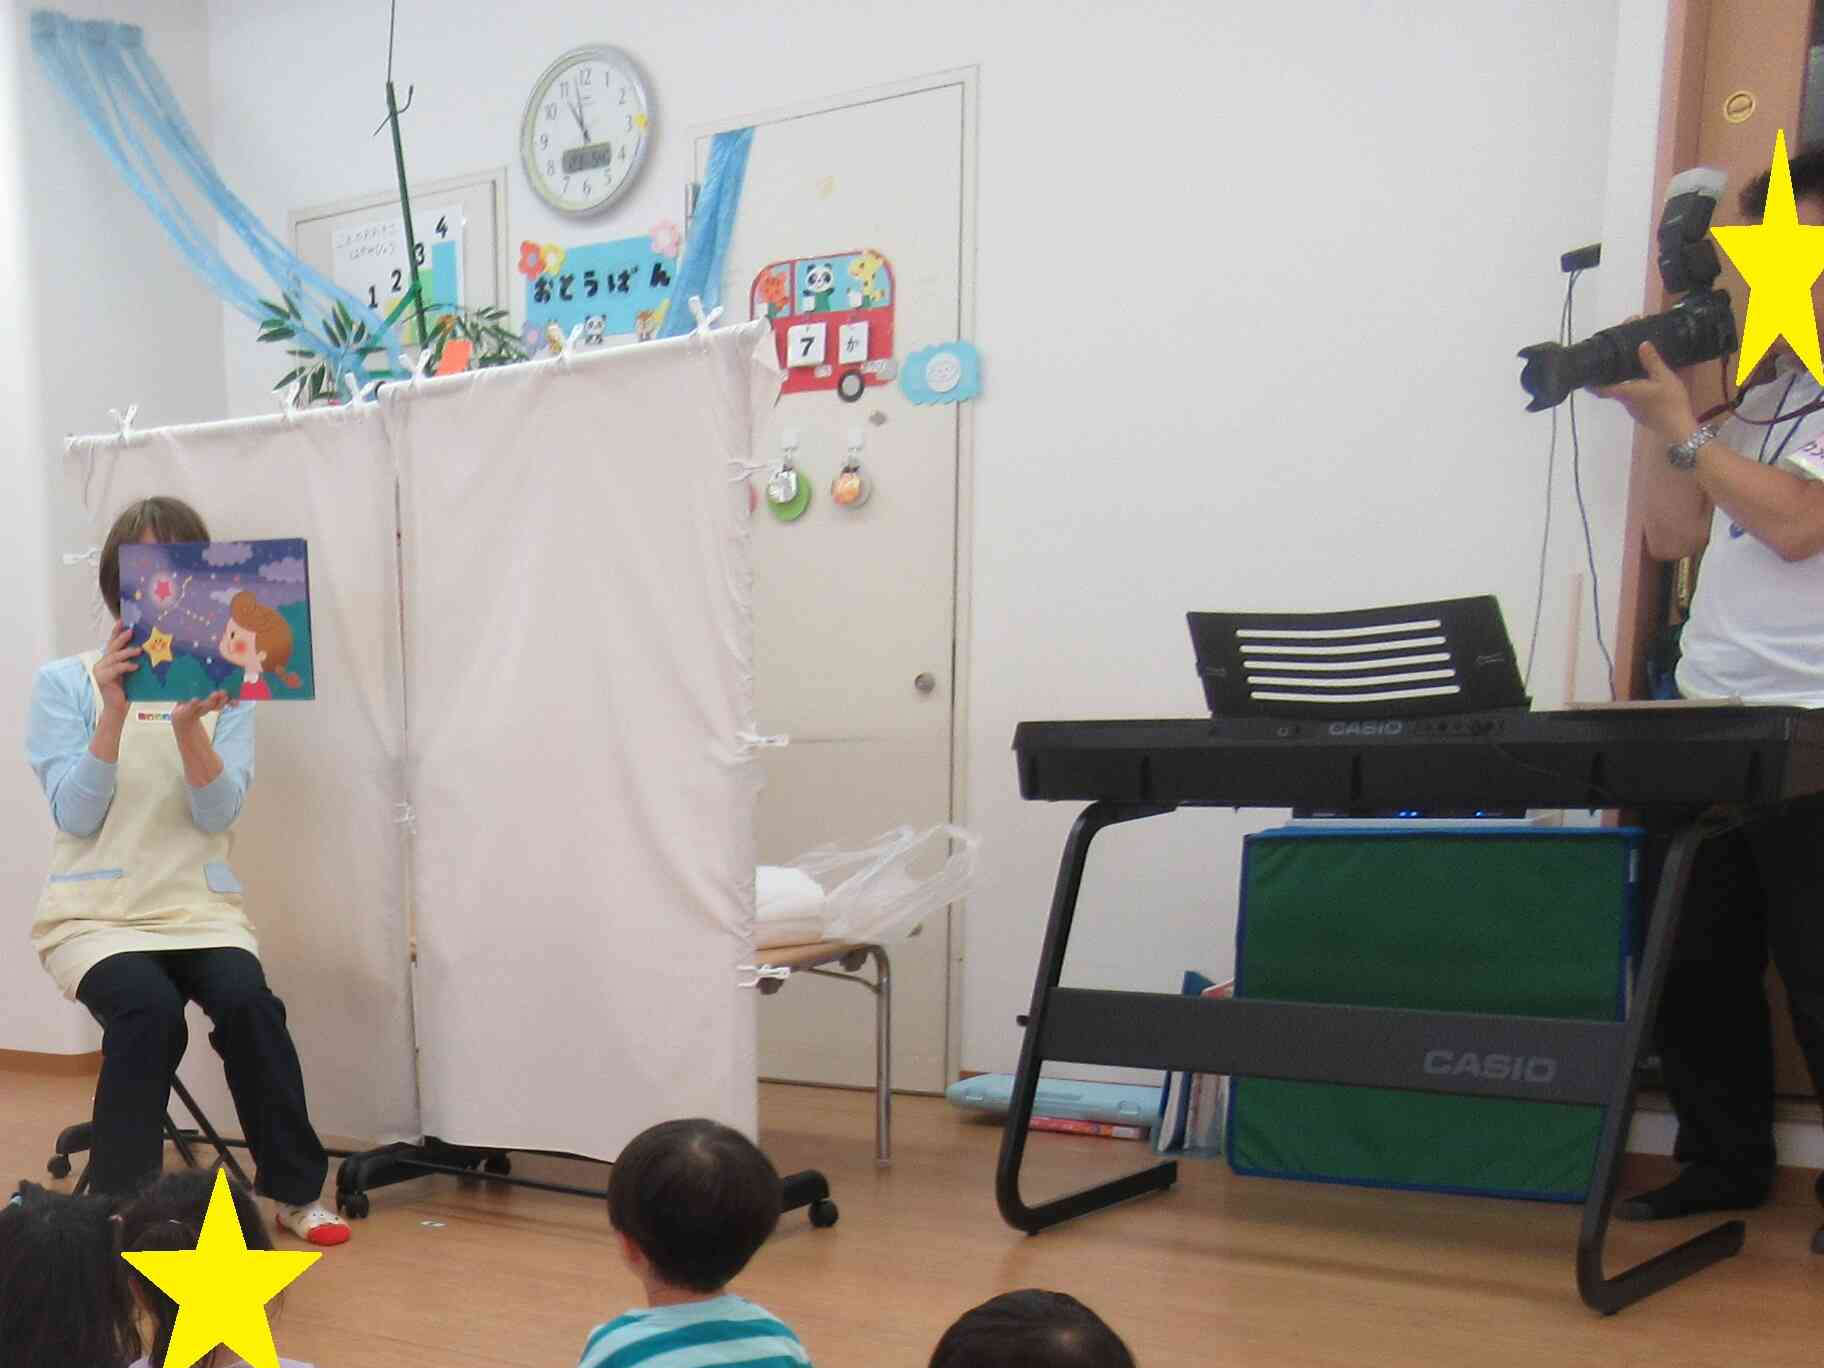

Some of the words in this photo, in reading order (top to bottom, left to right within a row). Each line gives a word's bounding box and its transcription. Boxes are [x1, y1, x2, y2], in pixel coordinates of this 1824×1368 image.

[579, 68, 592, 85] 12
[605, 72, 609, 88] 1
[560, 81, 569, 99] 11
[619, 87, 626, 104] 2
[544, 102, 557, 120] 10
[626, 115, 633, 132] 3
[540, 134, 549, 150] 9
[617, 145, 626, 160] 4
[547, 160, 555, 176] 8
[604, 168, 612, 185] 5
[561, 176, 570, 194] 7
[582, 177, 592, 198] 6
[435, 215, 448, 239] 4
[414, 242, 425, 266] 3
[390, 269, 402, 292] 2
[533, 262, 671, 304] おとうばん
[368, 285, 378, 309] 1
[800, 336, 815, 357] 7
[1328, 720, 1403, 736] CASIO
[1425, 1050, 1558, 1083] CASIO
